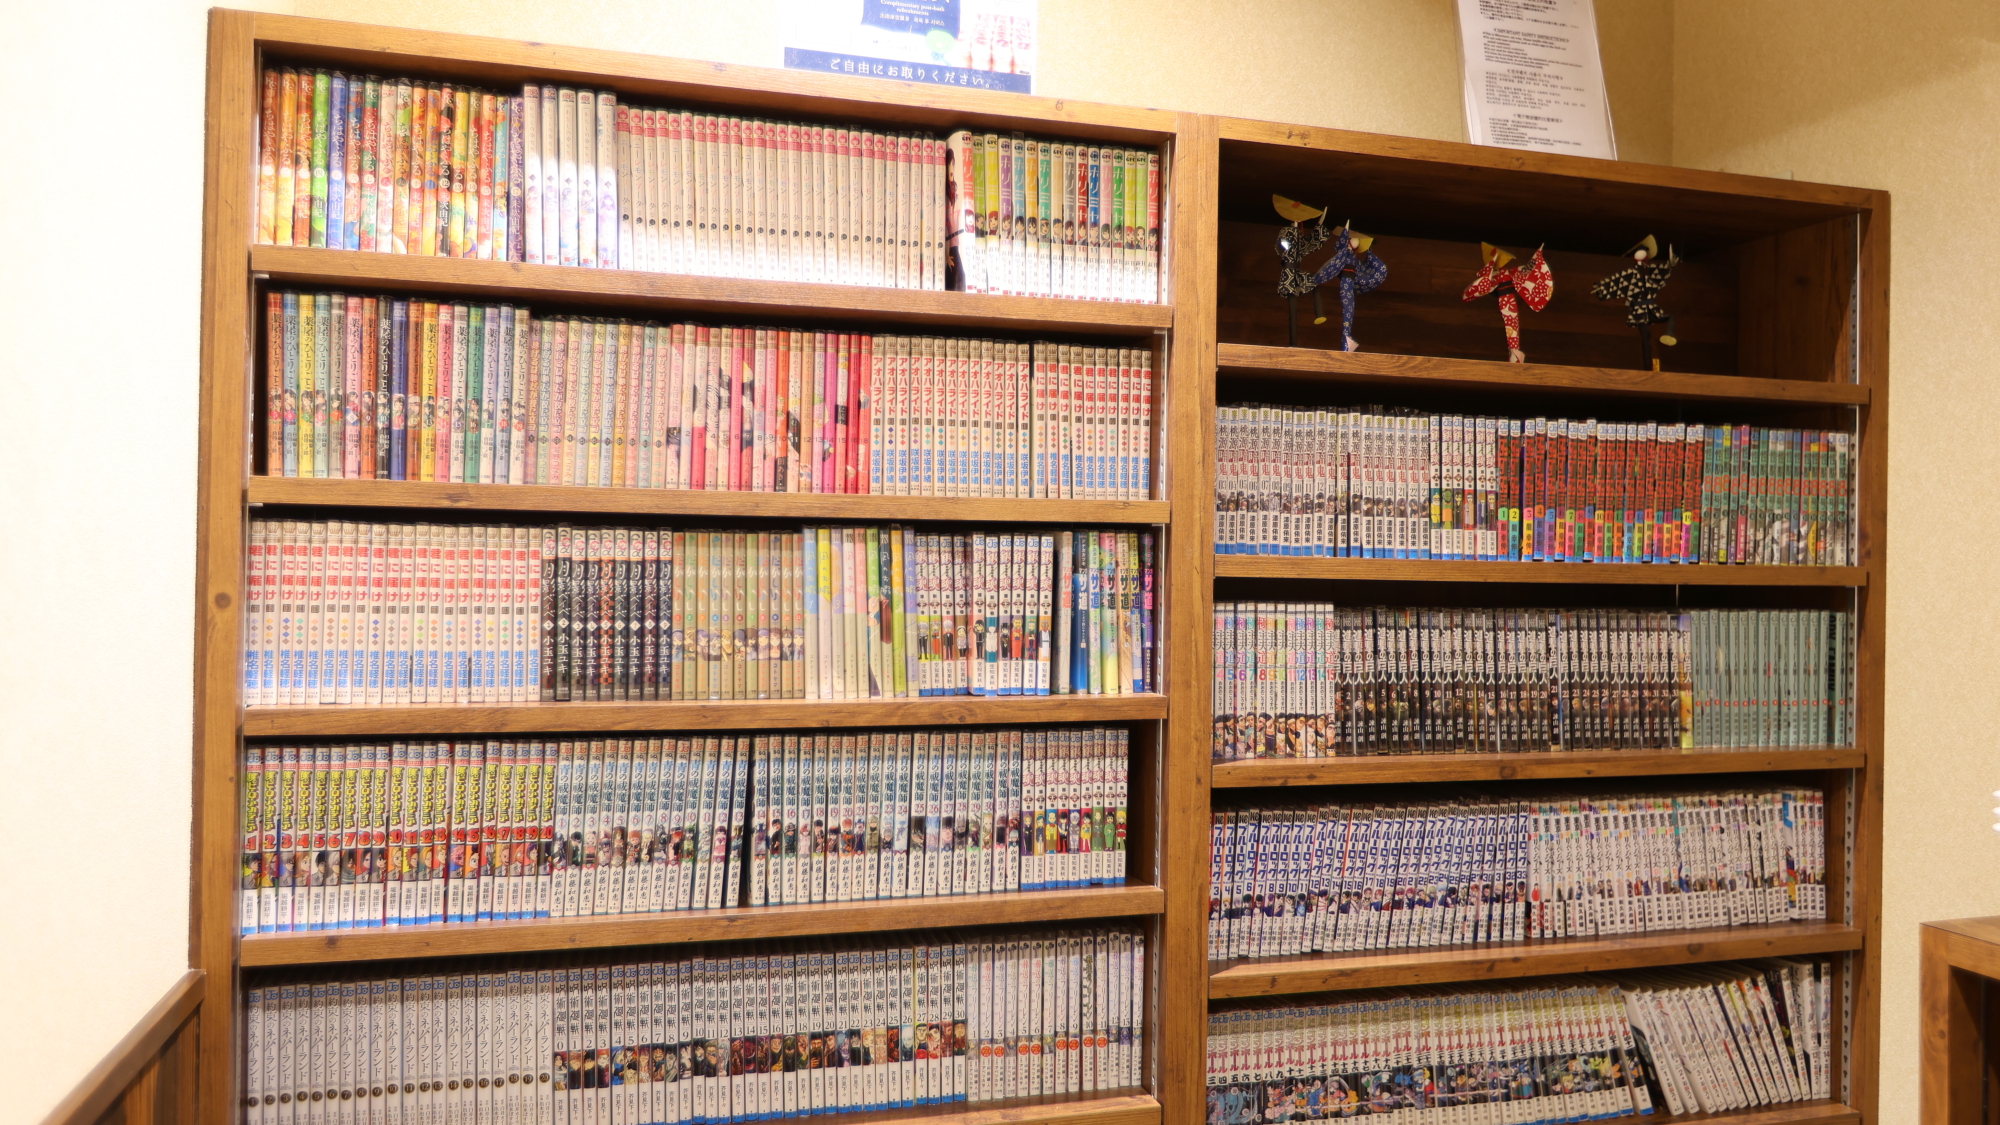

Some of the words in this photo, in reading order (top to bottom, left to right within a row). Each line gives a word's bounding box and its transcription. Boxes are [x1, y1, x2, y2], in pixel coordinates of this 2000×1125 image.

[830, 58, 990, 89] ご自由にお取りください。
[1079, 164, 1089, 222] ホリミヤ
[1090, 167, 1100, 222] ホリミヤ
[1113, 168, 1123, 225] ホリミヤ
[379, 319, 391, 393] 薬屋のひとりごと
[873, 357, 883, 416] アオハライド
[899, 358, 908, 417] アオハライド
[924, 358, 932, 417] アオハライド
[971, 359, 980, 417] アオハライド
[1047, 363, 1057, 411] 君に届け
[1073, 365, 1083, 413] 君に届け
[1121, 368, 1129, 414] 君に届け
[265, 544, 278, 601] 君に届け
[296, 545, 309, 601] 君に届け
[340, 546, 354, 601] 君に届け
[542, 562, 556, 618] 月影ベイベ
[572, 563, 586, 618] 月影ベイベ
[629, 563, 643, 618] 月影ベイベ
[659, 562, 672, 617] 月影ベイベ
[673, 555, 684, 610] だがしかし
[710, 555, 721, 611] だがしかし
[770, 555, 781, 610] だがしかし
[793, 556, 804, 610] だがしかし
[1078, 574, 1088, 610] サ道
[1091, 575, 1099, 609] サ道
[1107, 575, 1116, 610] サ道
[1144, 575, 1153, 610] サ道
[543, 636, 554, 676] 小玉ユキ
[572, 636, 583, 676] 小玉ユキ
[629, 635, 640, 676] 小玉ユキ
[659, 634, 670, 675] 小玉ユキ
[1257, 617, 1266, 664] 極主夫道
[1377, 627, 1387, 682] 進撃の巨人
[1409, 628, 1420, 683] 進撃の巨人
[1453, 627, 1463, 682] 進撃の巨人
[1227, 669, 1234, 680] 5
[1259, 669, 1266, 680] 8
[1296, 669, 1306, 680] 12
[1456, 688, 1463, 696] 12
[557, 763, 572, 815] 青の祓魔師
[587, 763, 601, 815] 青の祓魔師
[616, 761, 630, 813] 青の祓魔師
[914, 754, 925, 801] 青の祓魔師
[589, 817, 595, 827] 3
[914, 804, 925, 813] 25
[281, 833, 293, 849] 3
[314, 833, 326, 848] 5
[358, 831, 370, 846] 8
[1212, 826, 1223, 881] ブルーロック
[1245, 822, 1258, 877] ブルーロック
[1277, 824, 1291, 878] ブルーロック
[1441, 816, 1455, 869] ブルーロック
[1518, 815, 1528, 867] ブルーロック
[1213, 886, 1220, 895] 3
[1246, 882, 1253, 891] 6
[1278, 883, 1285, 892] 9
[1516, 870, 1527, 880] 33
[613, 980, 624, 1031] 呪術廻戦
[955, 959, 966, 1005] 呪術廻戦
[555, 985, 567, 1036] 呪術廻戦
[583, 982, 595, 1035] 呪術廻戦
[954, 1009, 965, 1018] 30
[264, 1002, 278, 1085] 約束のネバーランド
[326, 997, 340, 1079] 約束のネバーランド
[371, 996, 385, 1077] 約束のネバーランド
[557, 1041, 564, 1050] 0
[586, 1039, 593, 1048] 2
[614, 1035, 622, 1045] 4
